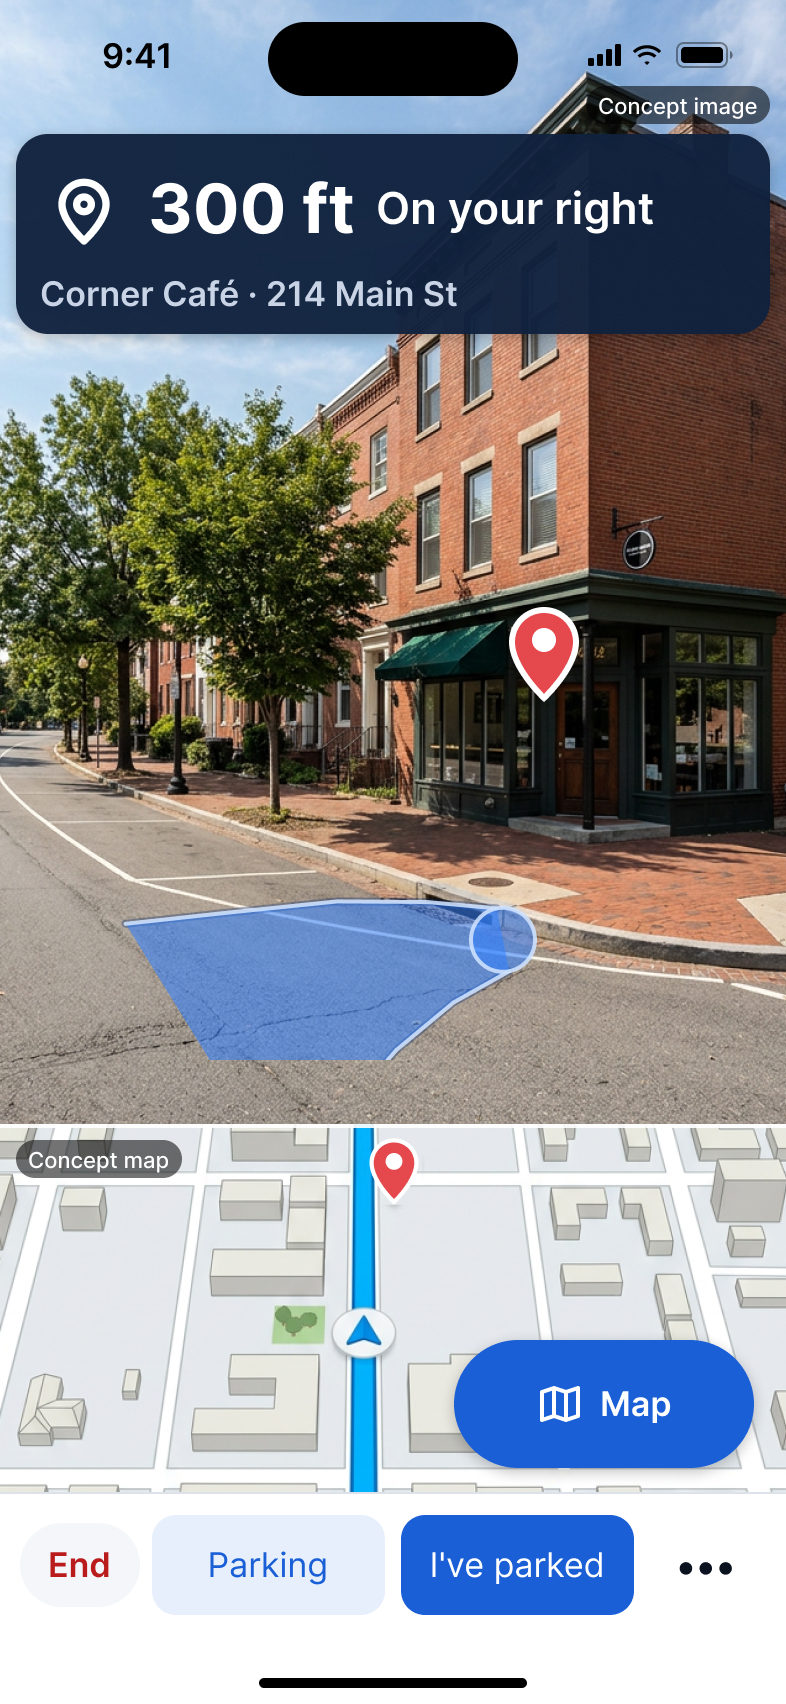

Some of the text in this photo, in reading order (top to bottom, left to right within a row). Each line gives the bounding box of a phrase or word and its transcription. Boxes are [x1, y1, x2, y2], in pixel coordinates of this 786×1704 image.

[104, 43, 171, 69] 9:41
[151, 181, 654, 235] 300 ft On your right
[42, 280, 153, 307] Corner
[164, 279, 239, 307] Café
[268, 280, 326, 307] 214
[336, 280, 413, 307] Main
[424, 280, 458, 307] St
[601, 1391, 671, 1424] Map
[49, 1552, 109, 1578] End
[209, 1551, 327, 1585] Parking
[431, 1551, 603, 1585] I've parked
